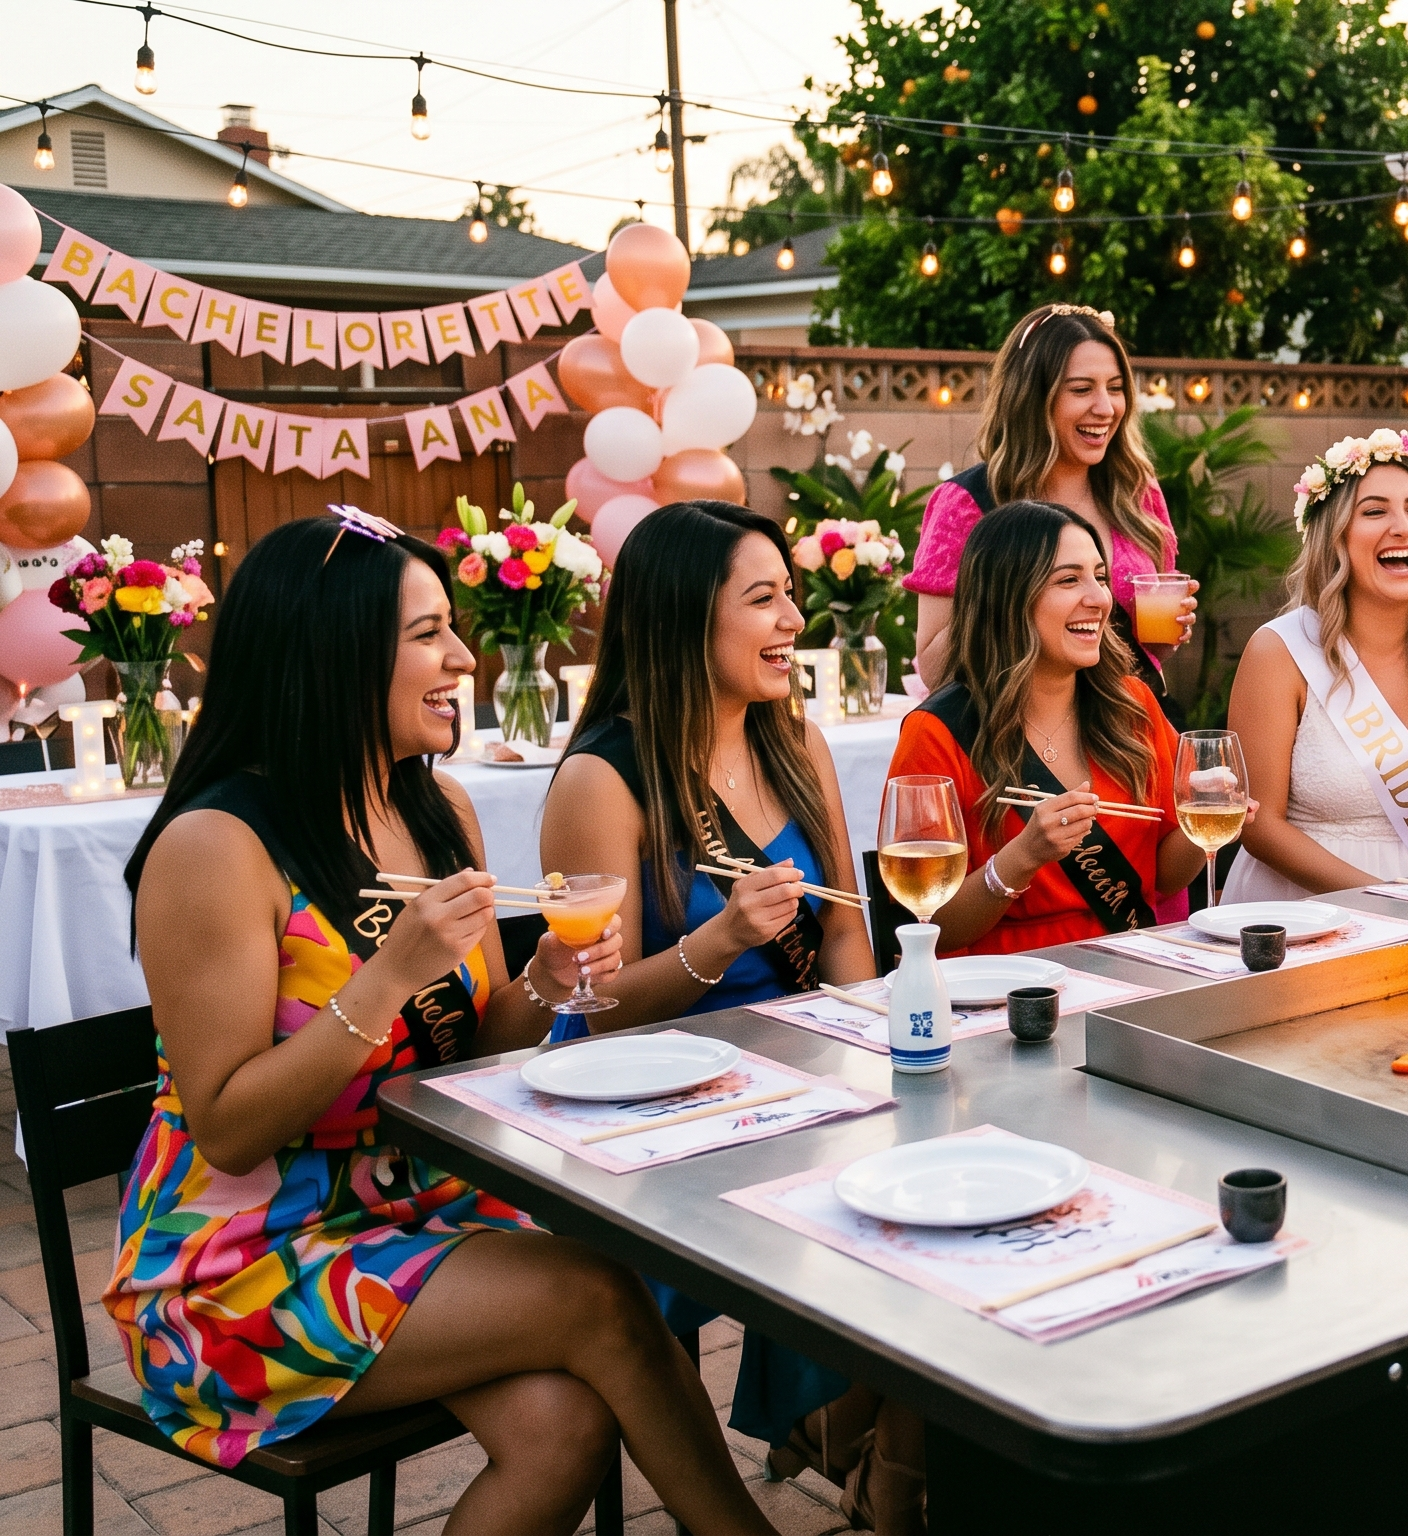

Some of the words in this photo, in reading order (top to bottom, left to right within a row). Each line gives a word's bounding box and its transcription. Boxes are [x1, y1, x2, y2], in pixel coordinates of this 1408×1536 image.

[60, 240, 586, 352] BACHELORETTE
[121, 373, 361, 460] SANTA
[421, 378, 555, 452] ANA
